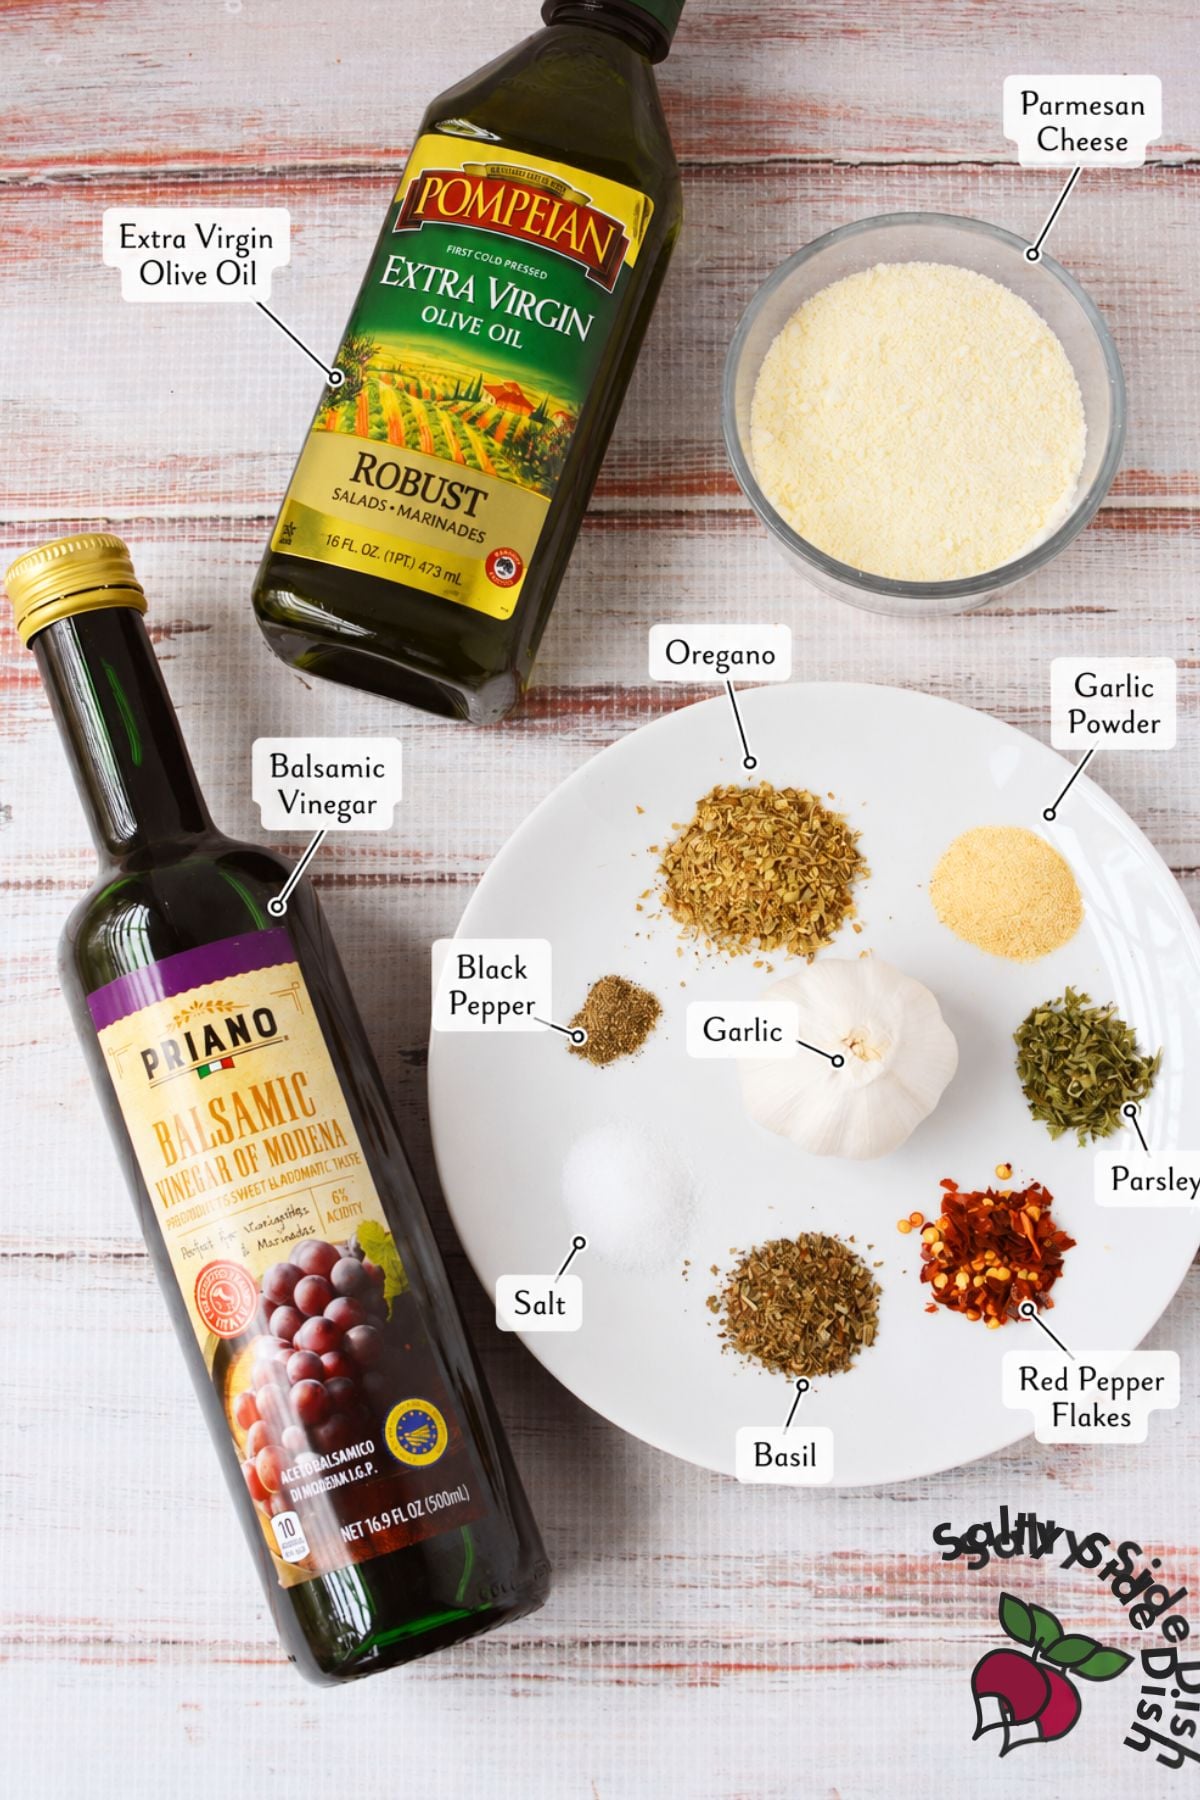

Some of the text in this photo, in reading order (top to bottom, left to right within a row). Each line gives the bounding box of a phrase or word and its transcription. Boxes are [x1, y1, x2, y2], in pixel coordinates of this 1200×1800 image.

[414, 177, 617, 265] POMPEIAN
[446, 244, 549, 281] FIRST COLD PRESSED
[379, 254, 597, 342] EXTRA VIRGIN
[420, 305, 524, 349] OLIVE OIL
[349, 451, 489, 518] ROBUST
[331, 487, 488, 545] SALADS MARINADES
[326, 534, 340, 548] 16
[341, 537, 358, 554] FL.
[361, 543, 380, 559] OZ.
[418, 561, 442, 578] 473
[443, 571, 463, 586] mL
[141, 1007, 279, 1081] PRIANO
[152, 1071, 317, 1168] BALSAMIC
[154, 1118, 349, 1209] VINEGAR OF MODENA
[326, 1202, 365, 1224] ACIDITY
[278, 1518, 296, 1538] 10
[340, 1520, 364, 1542] NET
[364, 1511, 391, 1534] 16.9
[391, 1507, 409, 1525] FL
[407, 1500, 425, 1519] OZ
